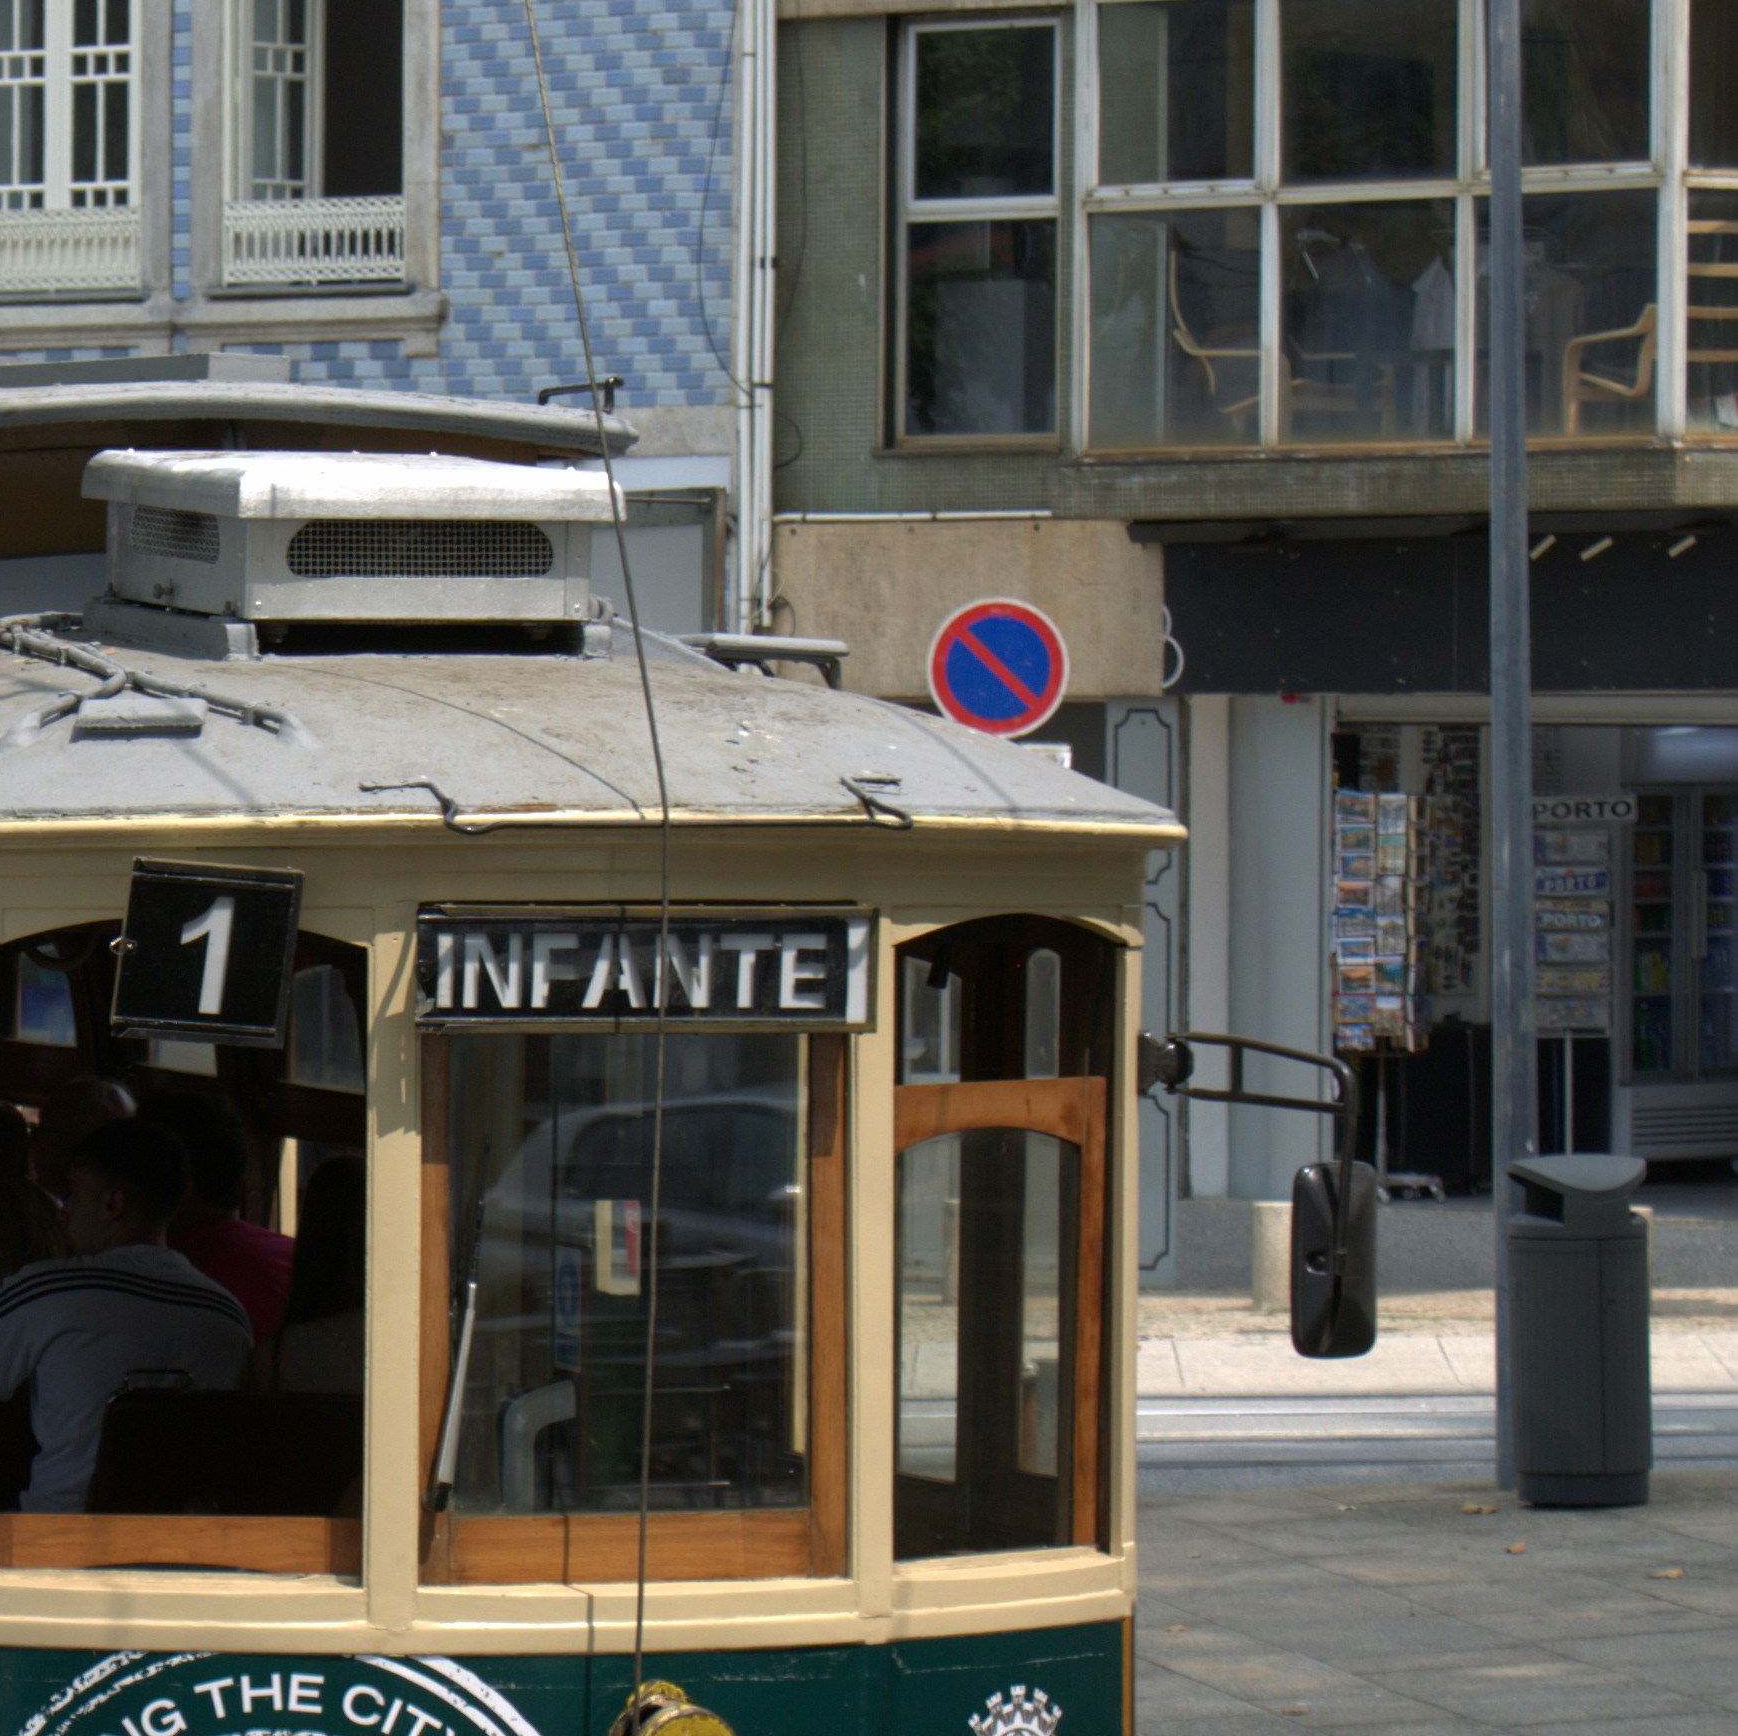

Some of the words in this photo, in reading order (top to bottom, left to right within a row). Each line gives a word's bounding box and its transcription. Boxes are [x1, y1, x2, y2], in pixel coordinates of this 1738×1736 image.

[1533, 799, 1632, 819] PORTO
[179, 895, 236, 1016] 1
[436, 931, 829, 1010] INFANTE
[193, 1672, 325, 1720] THE
